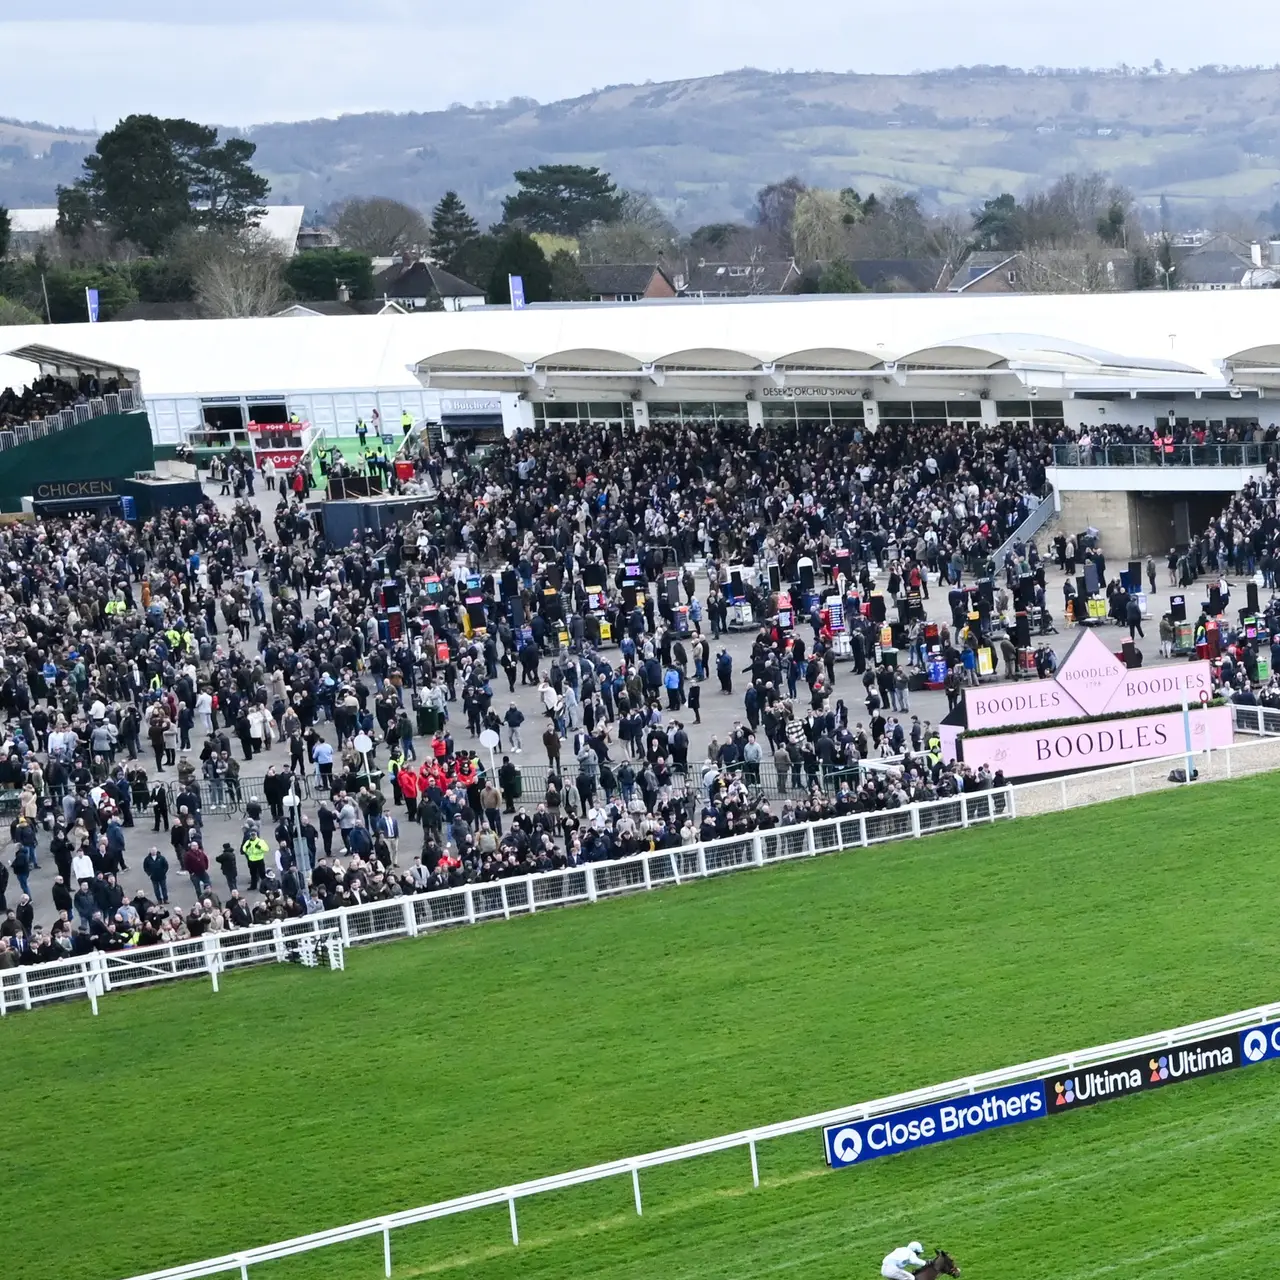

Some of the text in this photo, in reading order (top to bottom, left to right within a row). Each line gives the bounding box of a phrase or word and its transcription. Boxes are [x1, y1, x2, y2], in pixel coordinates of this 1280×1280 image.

[794, 387, 828, 396] ORCHID
[830, 387, 857, 396] STAND
[453, 400, 495, 411] Butcher's
[37, 480, 113, 498] CHICKEN
[1065, 666, 1120, 682] BOODLES
[1126, 673, 1206, 697] BOODLES
[976, 691, 1061, 716] BOODLES
[1036, 722, 1169, 762] BOODLES
[1075, 1044, 1234, 1101] Ultima Ultima
[867, 1089, 1043, 1152] Close Brothers
